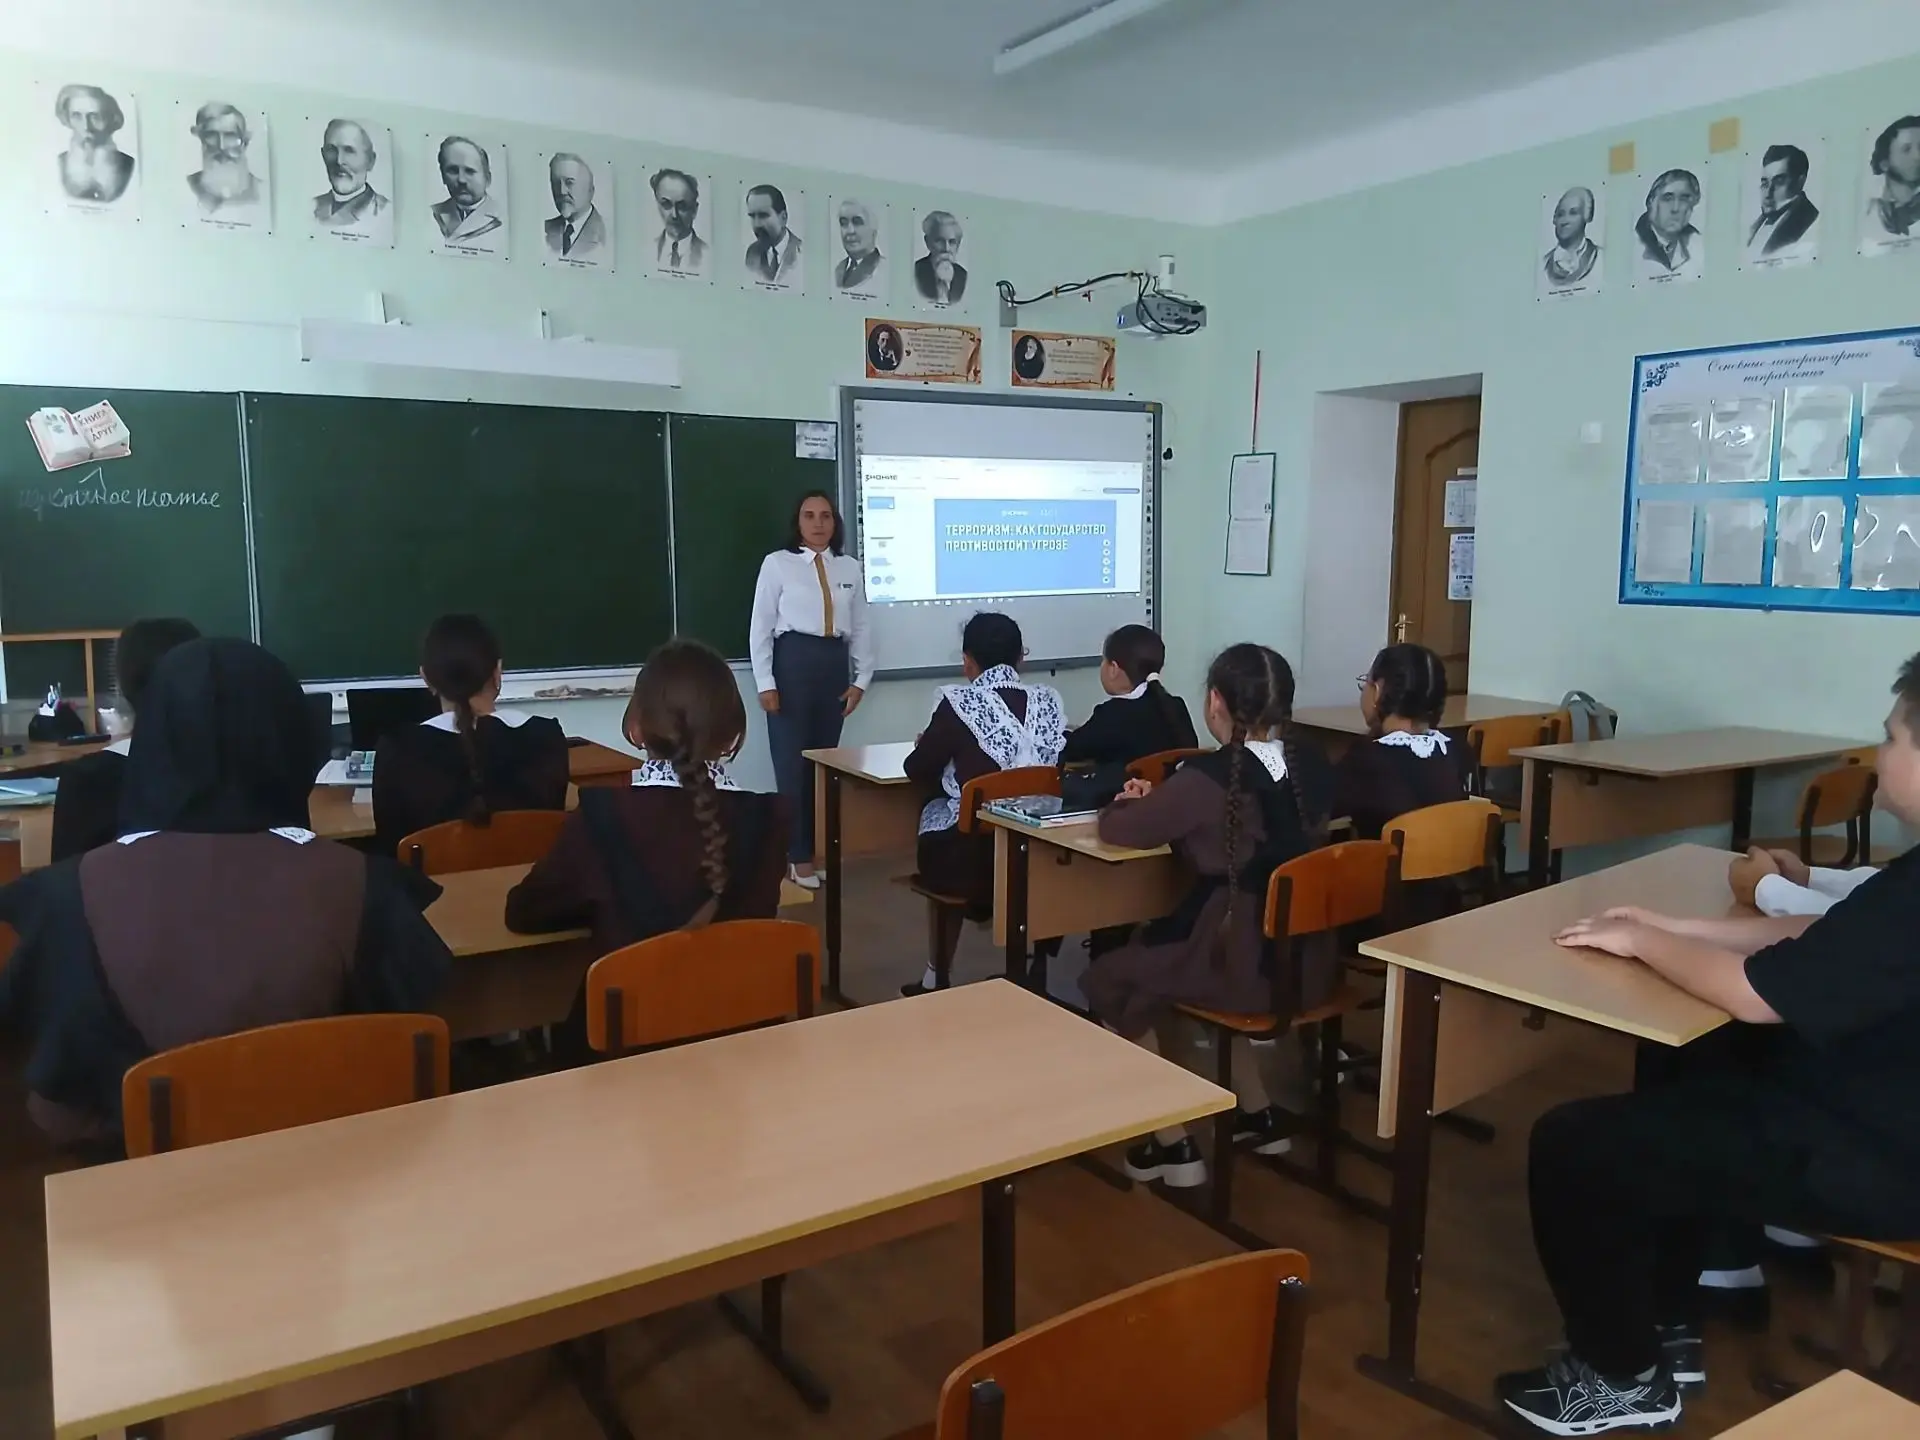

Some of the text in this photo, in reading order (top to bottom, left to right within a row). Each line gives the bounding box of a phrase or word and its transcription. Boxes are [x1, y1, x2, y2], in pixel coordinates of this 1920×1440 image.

[1707, 350, 1871, 372] Основные литературные
[1743, 369, 1825, 386] направления
[137, 488, 220, 508] платье
[945, 523, 1106, 537] ТЕРРОРИЗМ: КАК ГОСУДАРСТВО
[945, 539, 1067, 552] ПРОТИВОСТОИТ УГРОЗЕ
